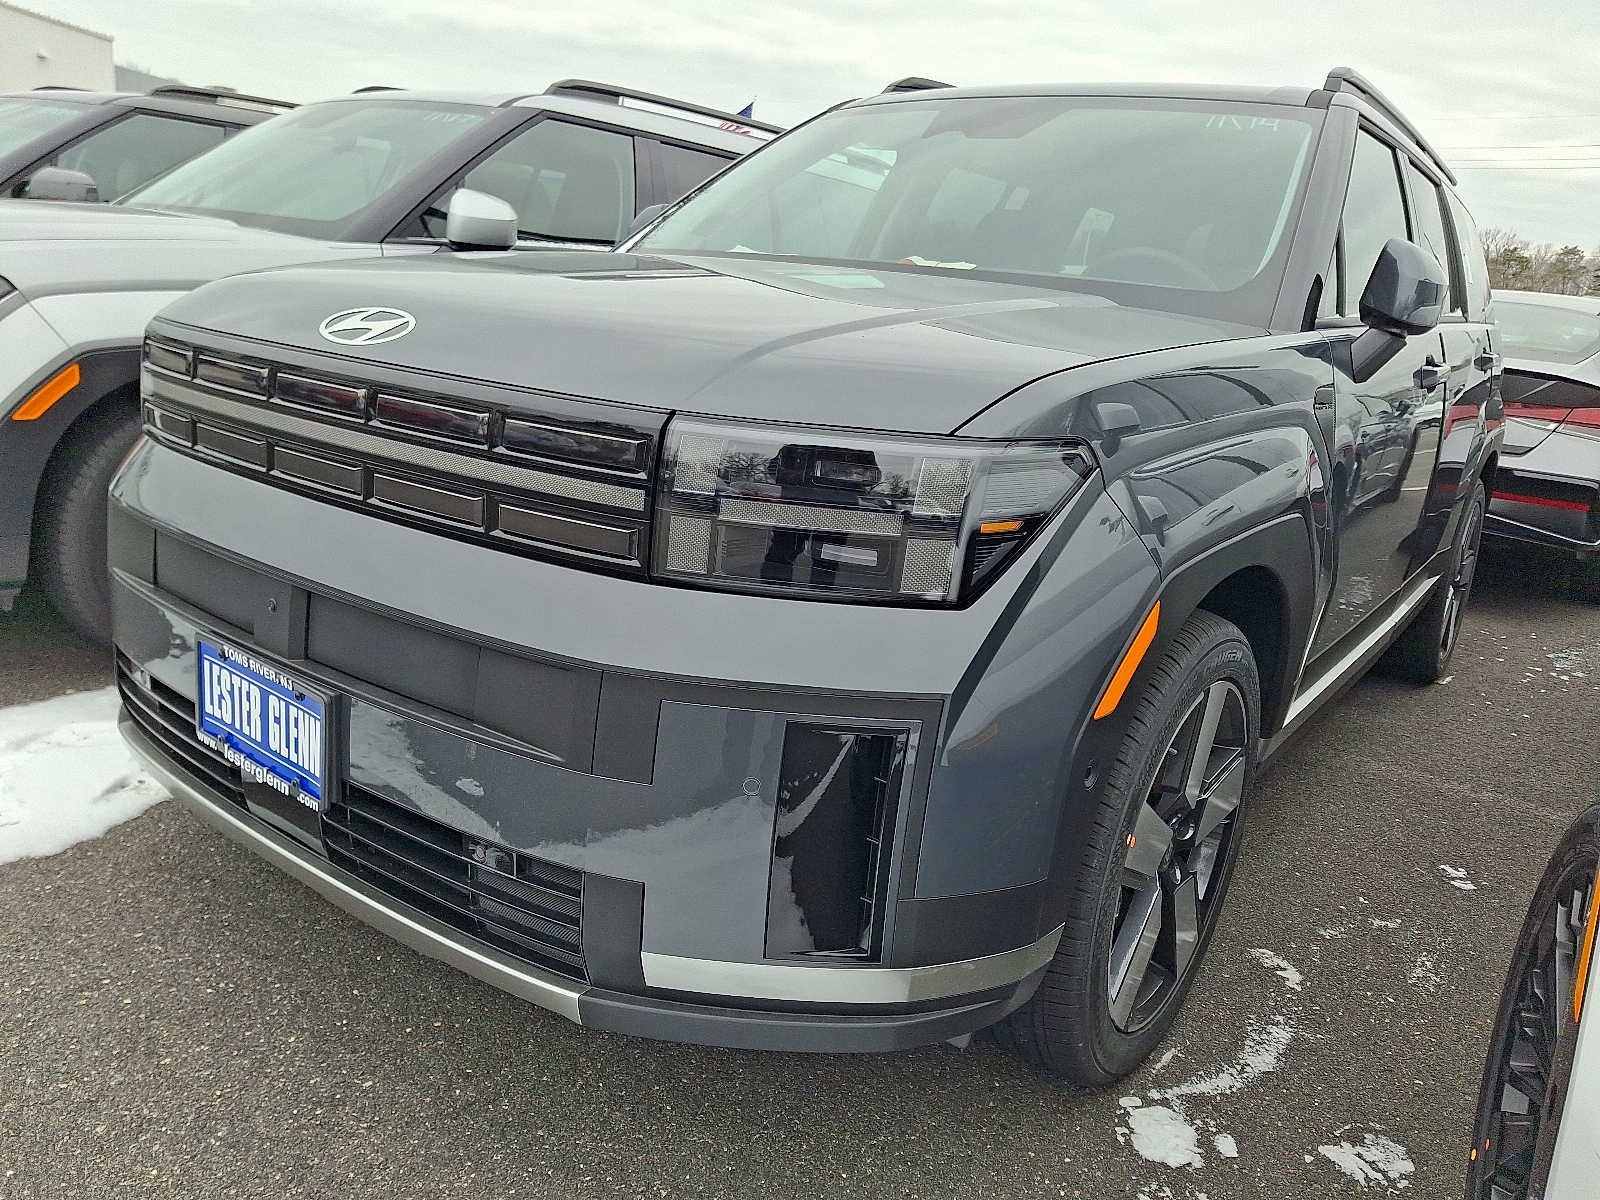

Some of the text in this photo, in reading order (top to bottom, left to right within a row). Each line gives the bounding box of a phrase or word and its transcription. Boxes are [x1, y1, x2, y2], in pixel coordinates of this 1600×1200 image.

[223, 645, 249, 668] TOMS
[203, 659, 321, 779] LESTER GLENN
